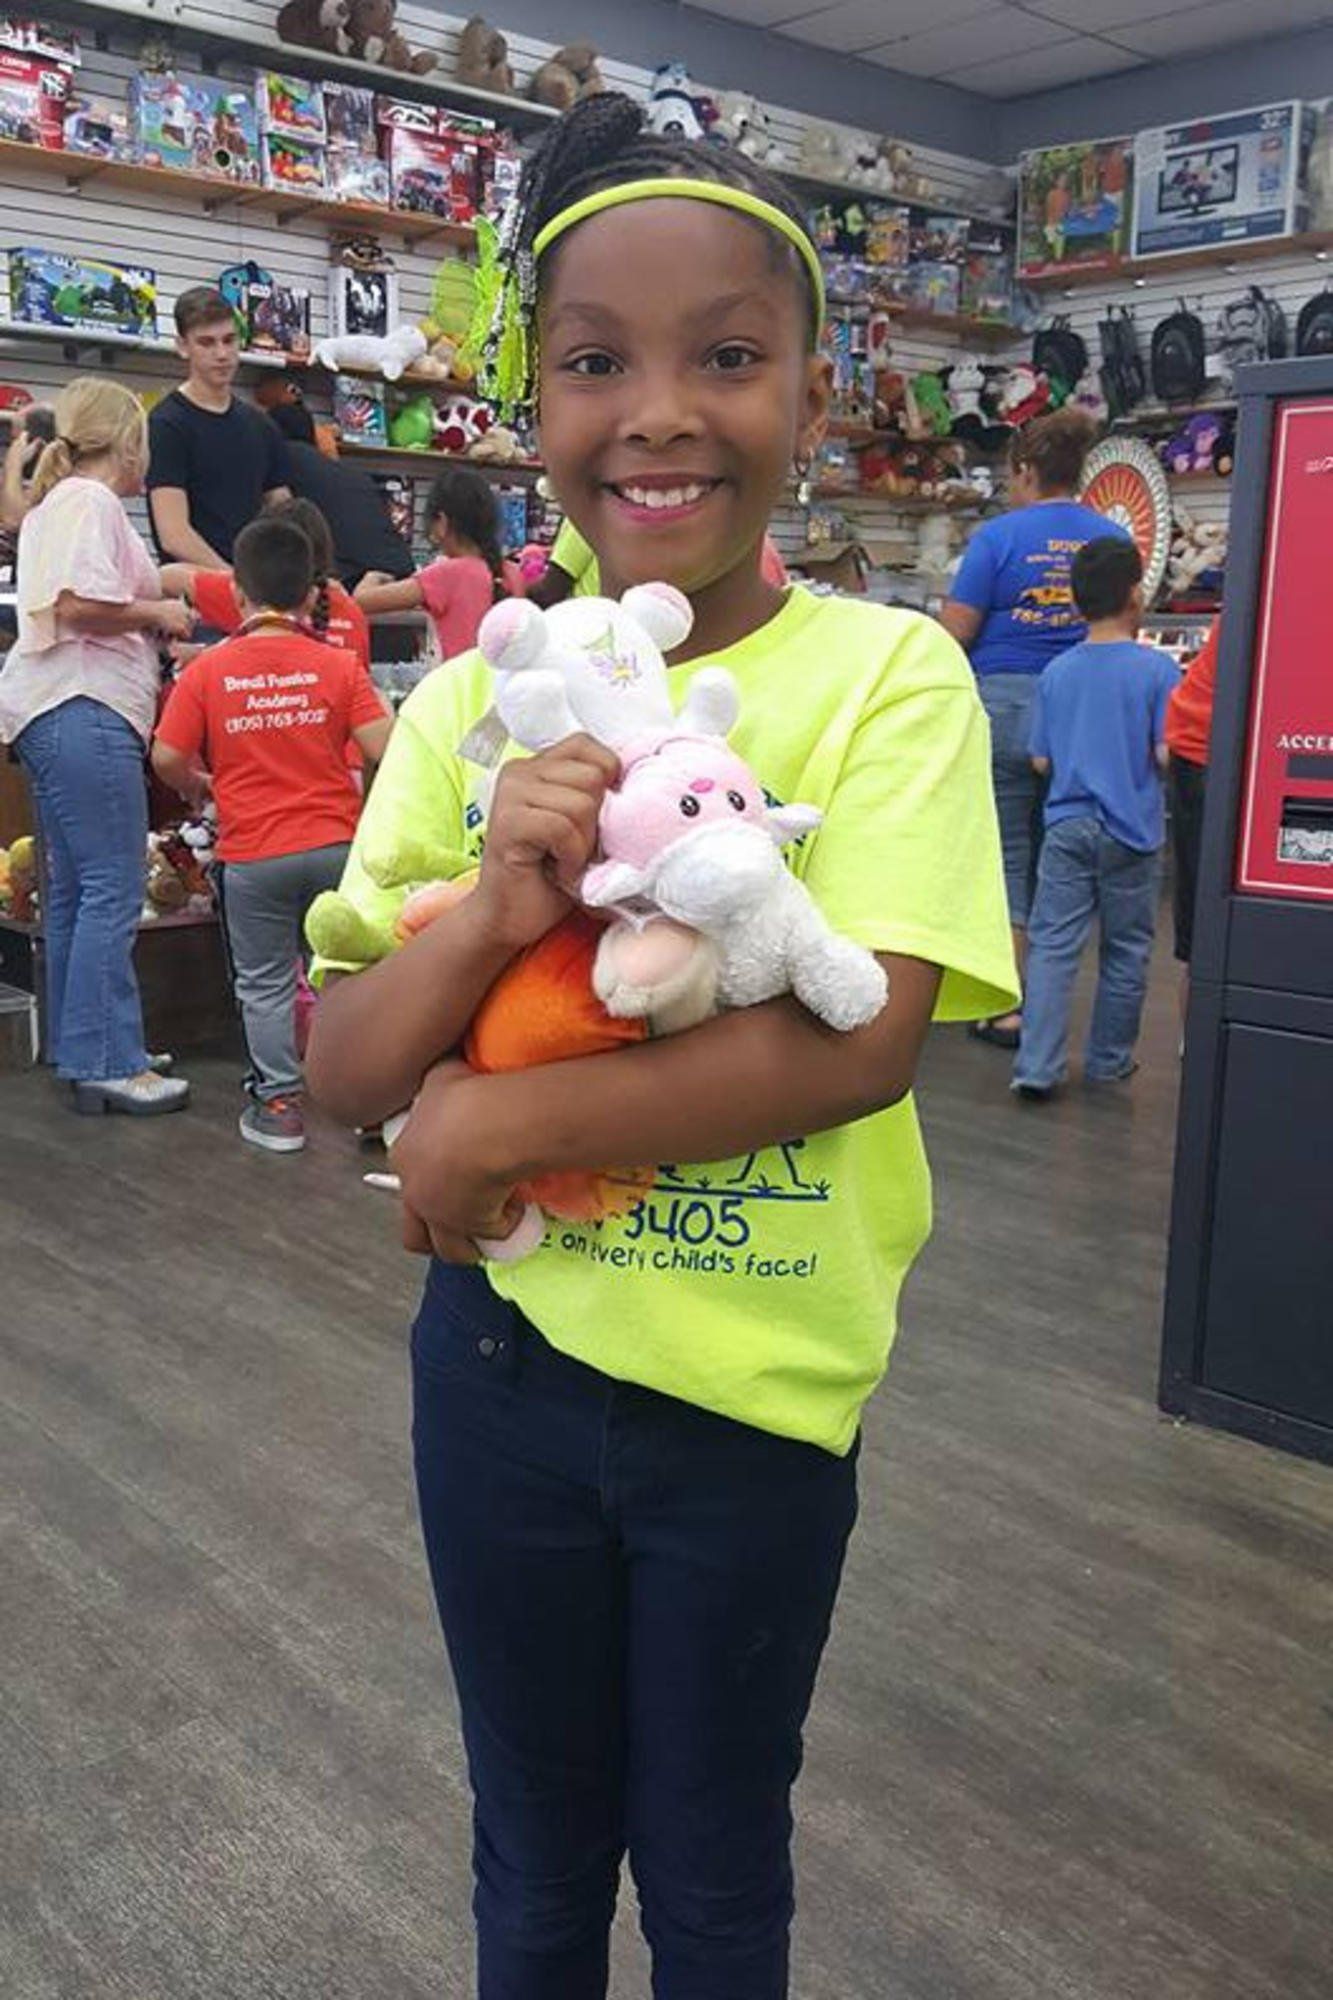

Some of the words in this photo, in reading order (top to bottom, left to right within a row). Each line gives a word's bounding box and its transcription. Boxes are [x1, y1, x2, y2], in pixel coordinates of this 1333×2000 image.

[560, 1232, 587, 1254] on
[652, 1246, 736, 1275] child's
[744, 1253, 818, 1278] face!
